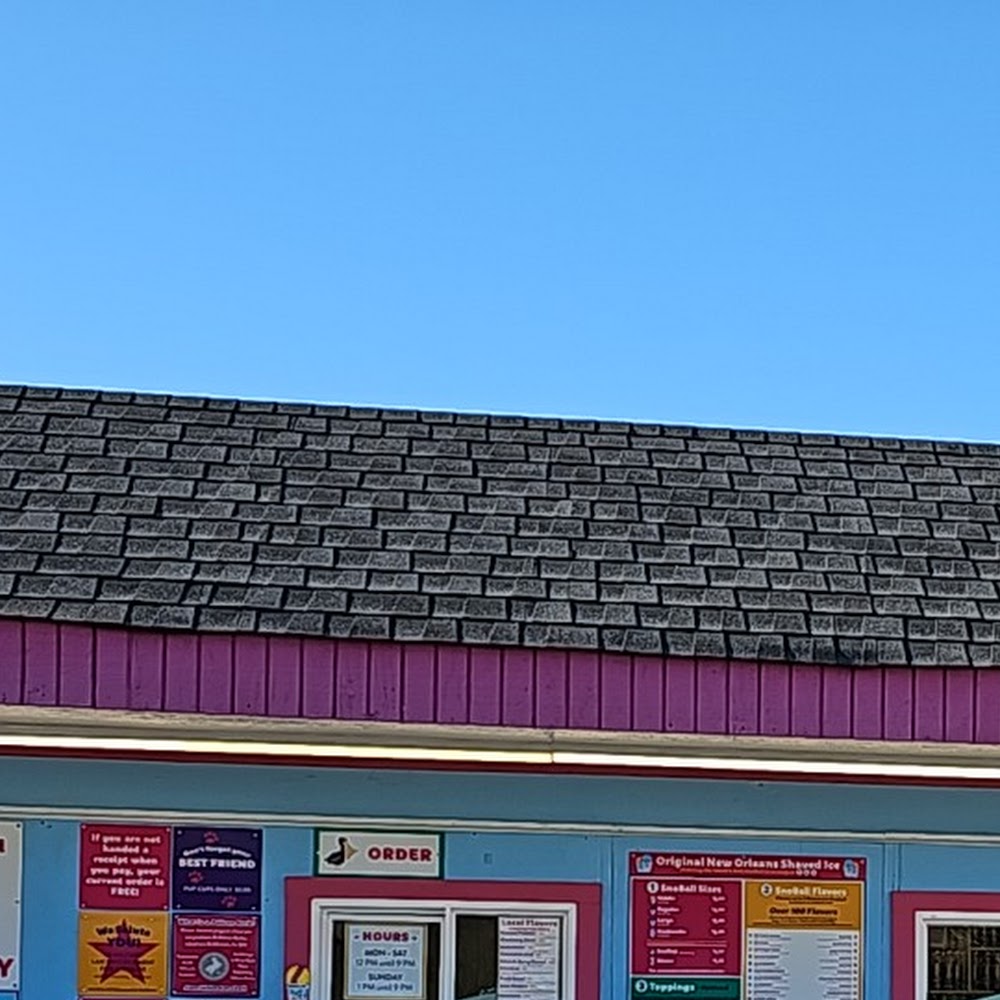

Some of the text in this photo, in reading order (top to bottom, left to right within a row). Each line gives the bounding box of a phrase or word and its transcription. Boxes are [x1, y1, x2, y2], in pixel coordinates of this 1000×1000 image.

[92, 833, 100, 842] If
[102, 835, 121, 844] you
[102, 844, 139, 854] handed
[368, 847, 432, 862] ORDER
[93, 856, 158, 866] receipt when
[178, 858, 256, 868] BEST FRIEND
[656, 856, 840, 870] Original New Orleans Shaved Ice
[126, 877, 153, 886] order
[362, 931, 409, 942] HOURS
[650, 982, 696, 992] Toppings
